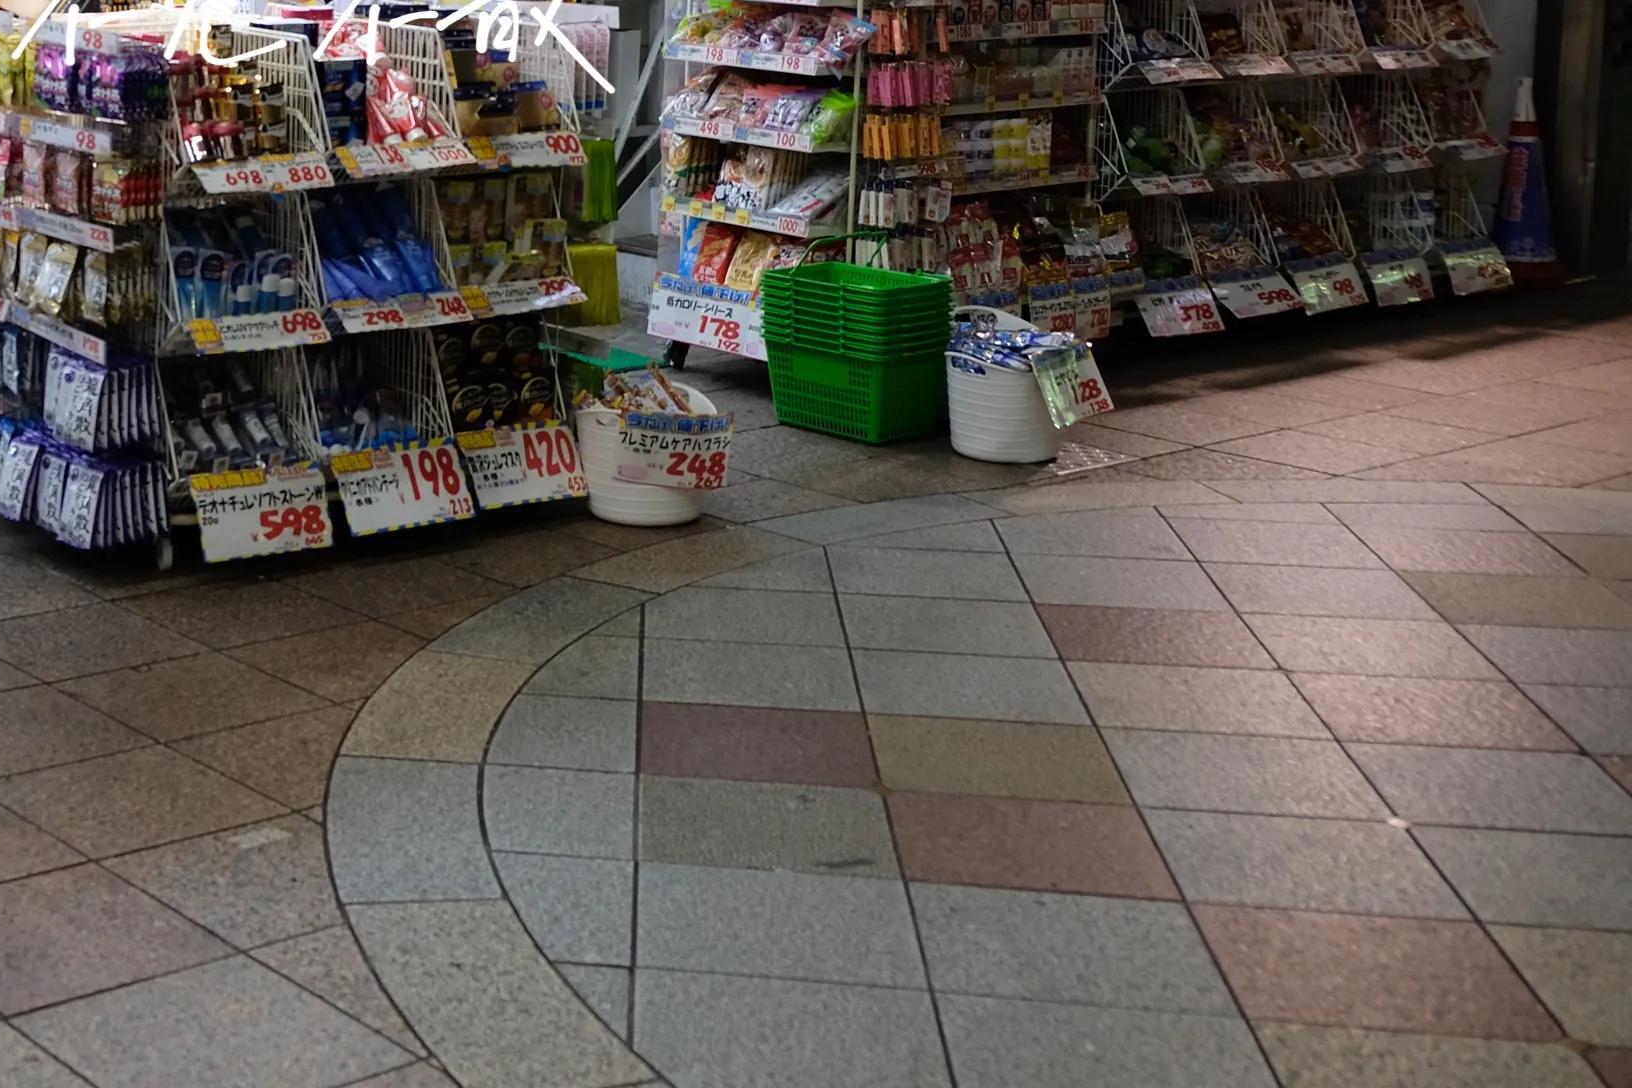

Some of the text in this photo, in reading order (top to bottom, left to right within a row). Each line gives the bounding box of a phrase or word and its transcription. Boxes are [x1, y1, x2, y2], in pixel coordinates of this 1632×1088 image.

[82, 32, 103, 48] 98
[706, 47, 724, 62] 198
[781, 57, 800, 71] 198
[700, 121, 718, 135] 498
[75, 131, 96, 149] 98
[546, 134, 579, 154] 900
[776, 132, 796, 147] 100
[226, 170, 262, 186] 698
[288, 166, 327, 183] 880
[778, 218, 798, 232] 1000
[1333, 278, 1355, 295] 98
[282, 311, 321, 332] 698
[367, 309, 403, 324] 298
[699, 315, 740, 339] 178
[718, 339, 740, 352] 192
[523, 429, 575, 478] 420
[667, 452, 726, 476] 248
